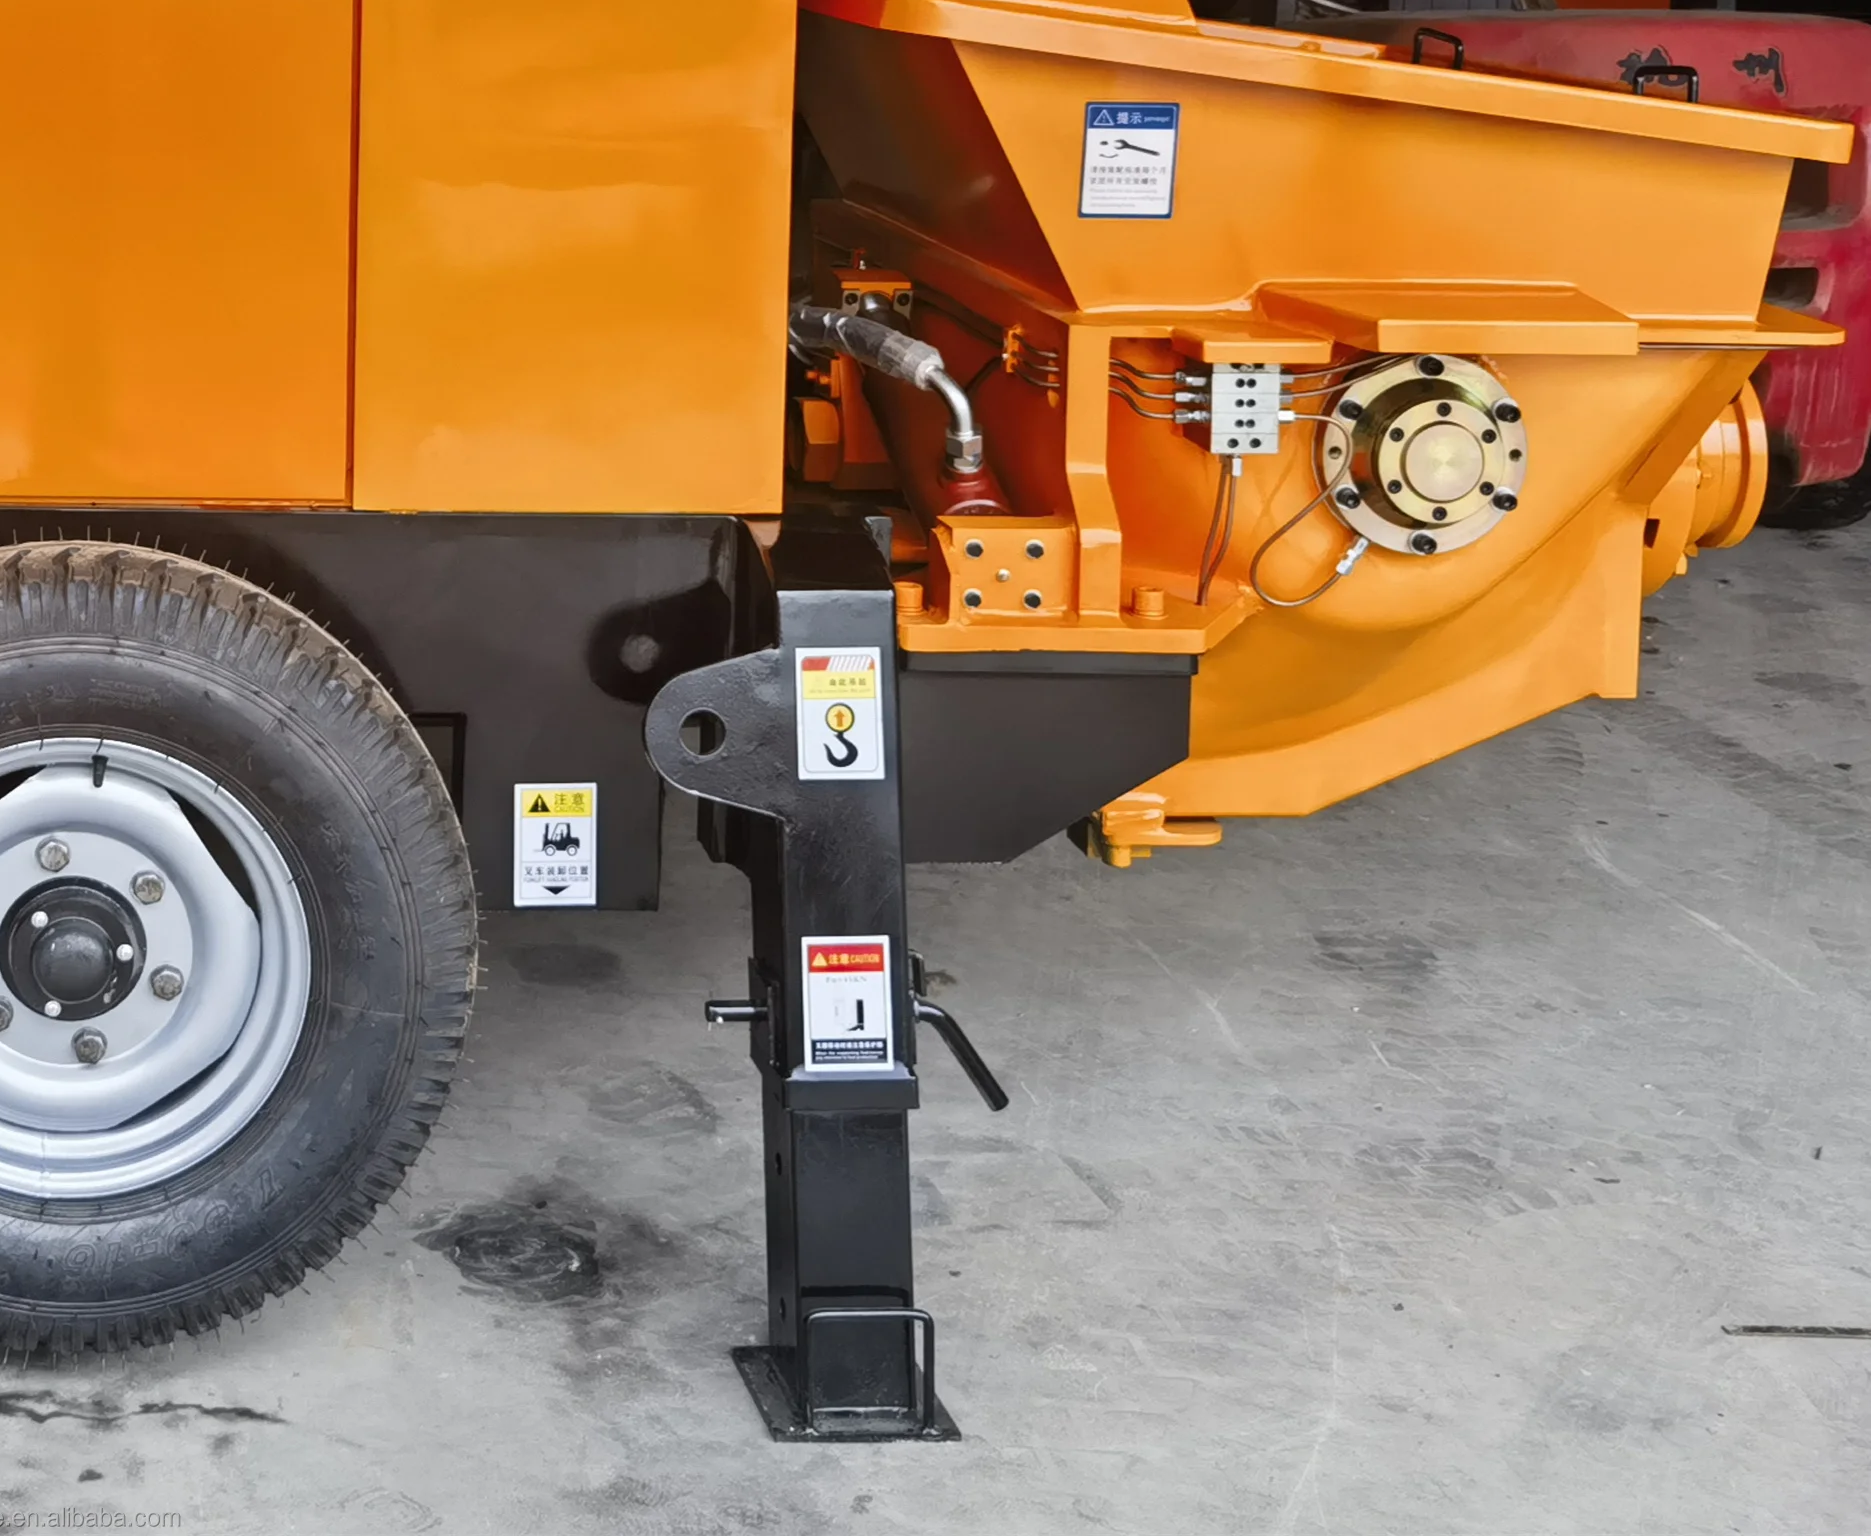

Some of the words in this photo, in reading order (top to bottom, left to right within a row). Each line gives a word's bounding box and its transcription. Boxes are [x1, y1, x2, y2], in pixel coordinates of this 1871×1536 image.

[1116, 112, 1142, 124] 提示
[554, 792, 585, 805] 注意
[524, 865, 589, 876] 叉车装卸位置
